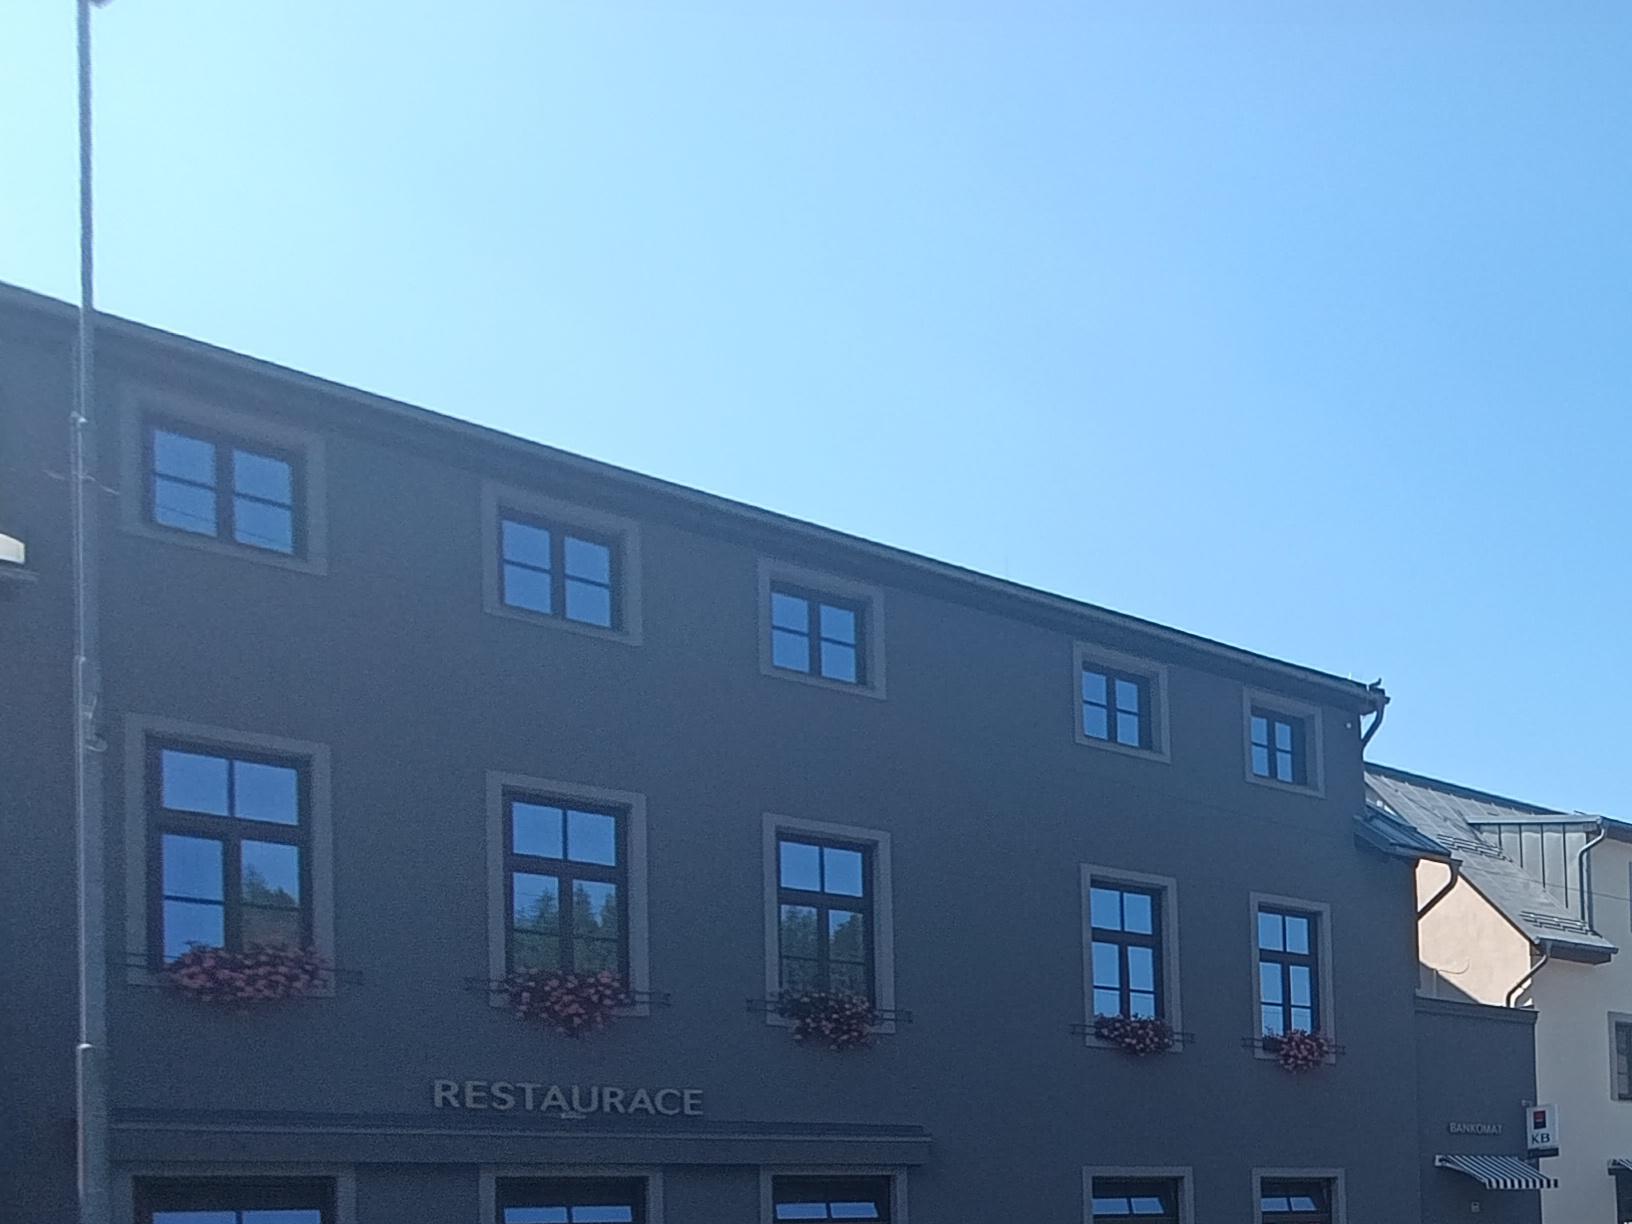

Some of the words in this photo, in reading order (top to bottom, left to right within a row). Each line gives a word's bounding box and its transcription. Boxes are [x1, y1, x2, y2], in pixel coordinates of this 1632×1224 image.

[433, 1079, 704, 1116] RESTAURACE
[1449, 1122, 1503, 1136] BANKOMAT
[1531, 1132, 1551, 1145] KB
